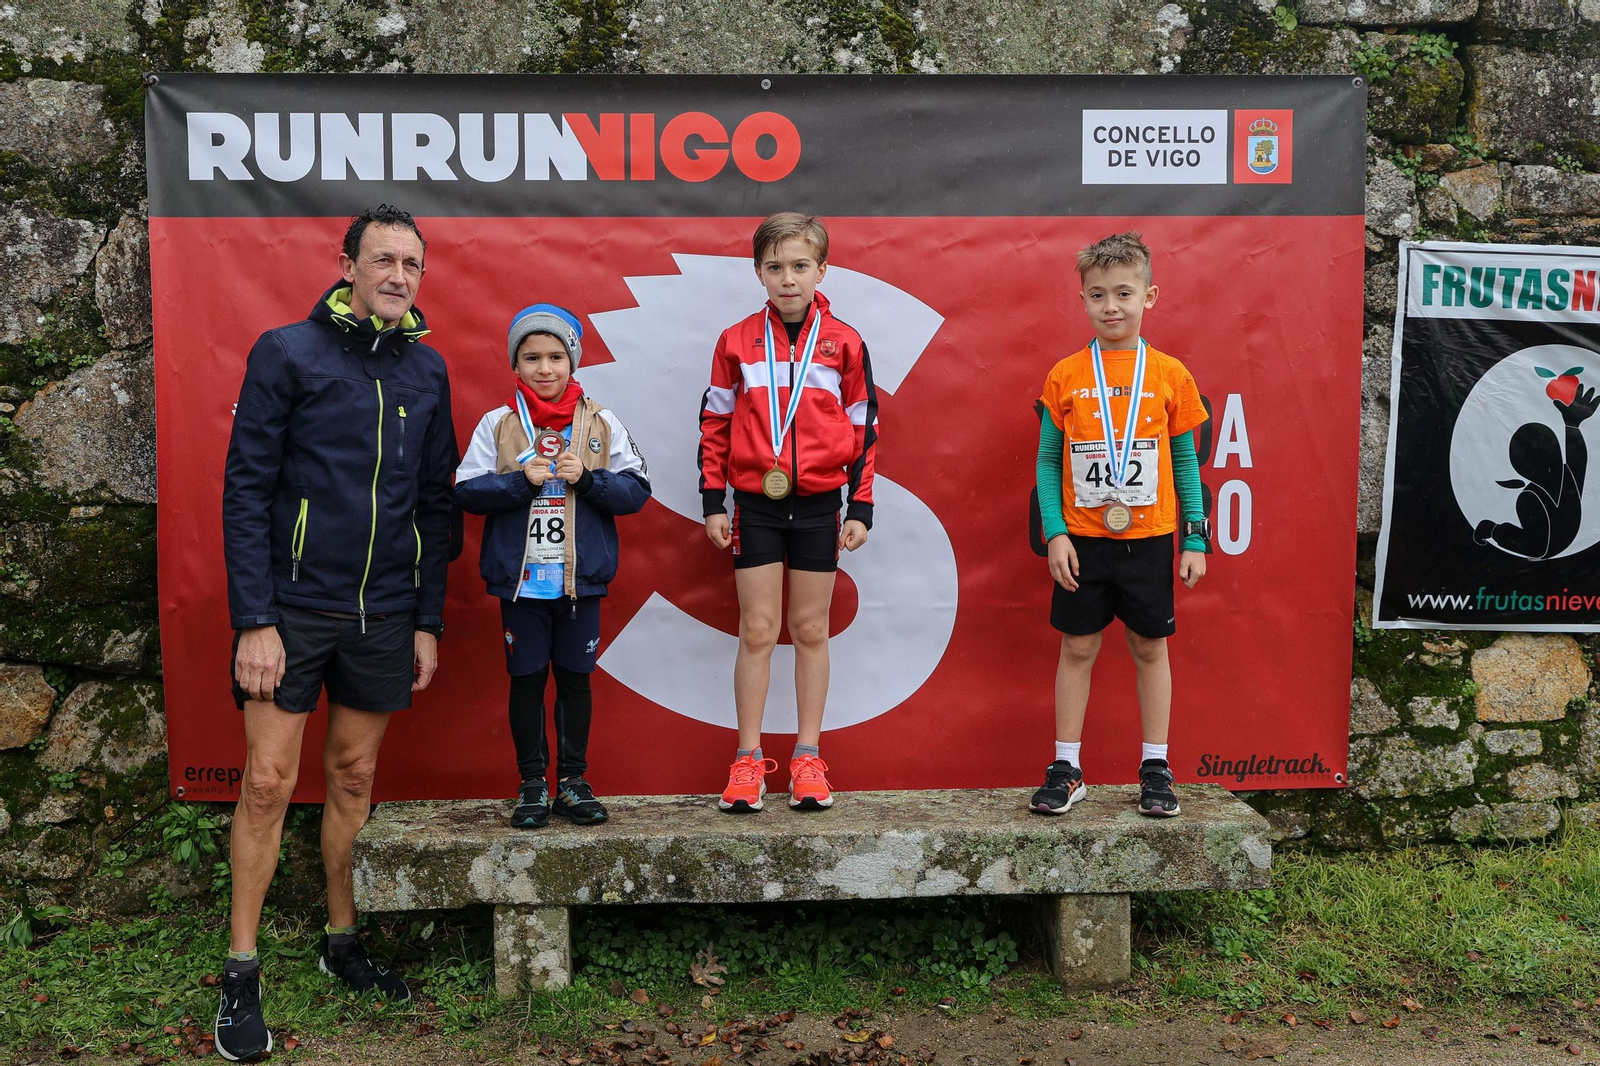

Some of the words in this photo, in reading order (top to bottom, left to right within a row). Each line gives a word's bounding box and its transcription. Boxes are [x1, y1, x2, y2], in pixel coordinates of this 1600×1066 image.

[1093, 125, 1216, 144] CONCELLO
[1108, 149, 1137, 168] DE
[1145, 149, 1201, 168] VIGO
[1421, 263, 1600, 312] FRUTASN
[1085, 460, 1143, 488] 482
